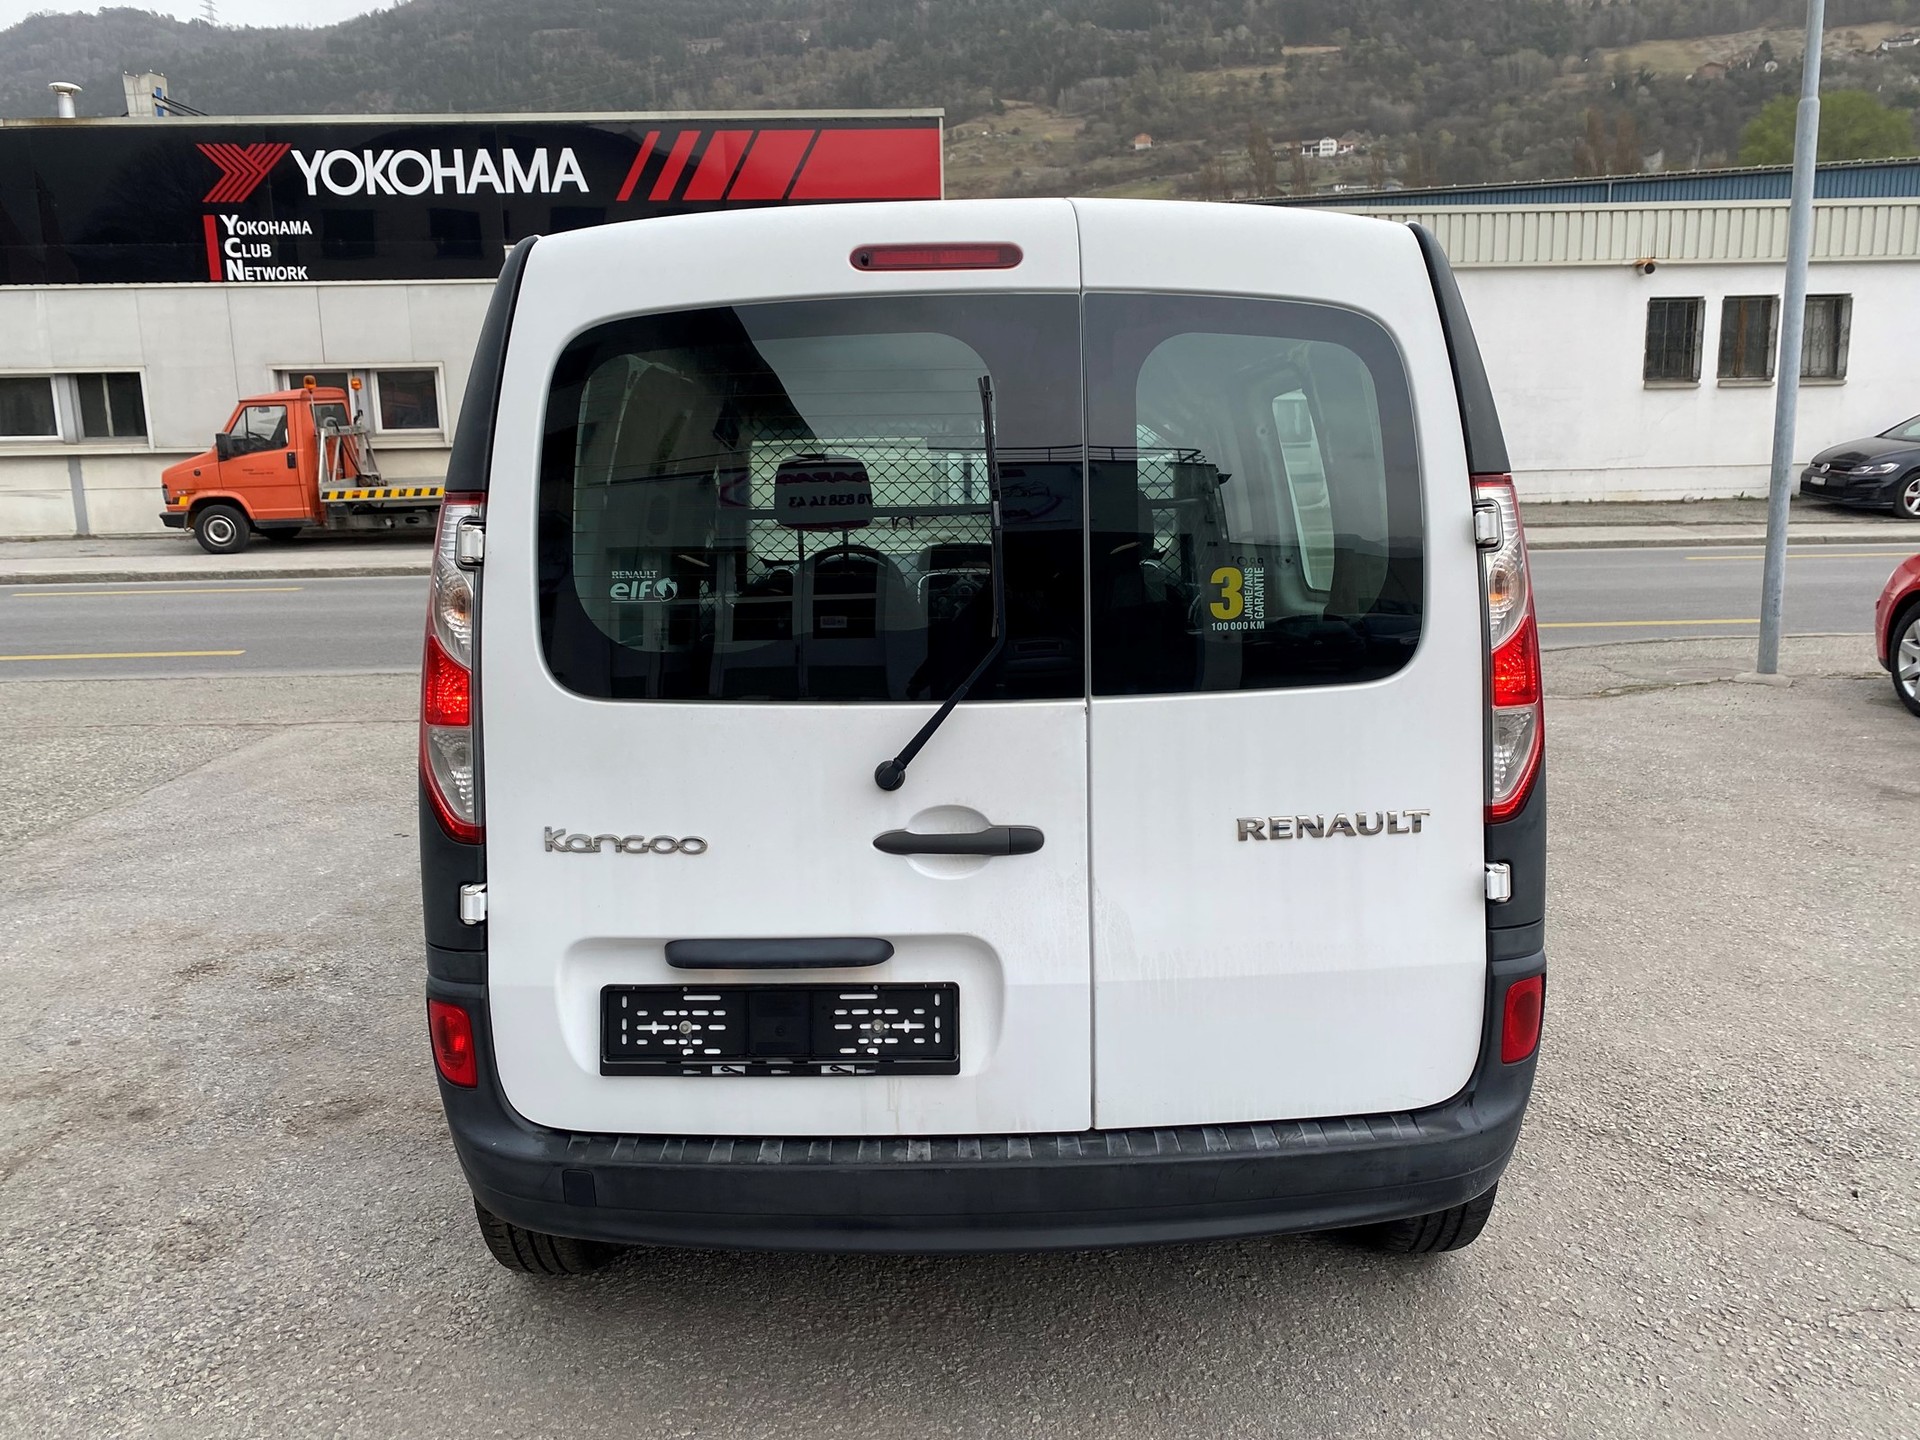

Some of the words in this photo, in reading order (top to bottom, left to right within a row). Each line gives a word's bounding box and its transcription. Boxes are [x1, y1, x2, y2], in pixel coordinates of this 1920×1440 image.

[291, 148, 589, 196] YOKOHAMA
[219, 214, 312, 235] YOKOHAMA
[224, 237, 272, 258] CLUB
[226, 259, 309, 280] NETWORK
[611, 570, 658, 579] RENAULT
[610, 580, 652, 600] elf
[1210, 567, 1243, 620] 3
[1244, 567, 1253, 619] JAHRE/ANS
[1254, 567, 1265, 619] GARANTIE
[1250, 621, 1265, 630] KM
[1236, 809, 1431, 842] RENAULT
